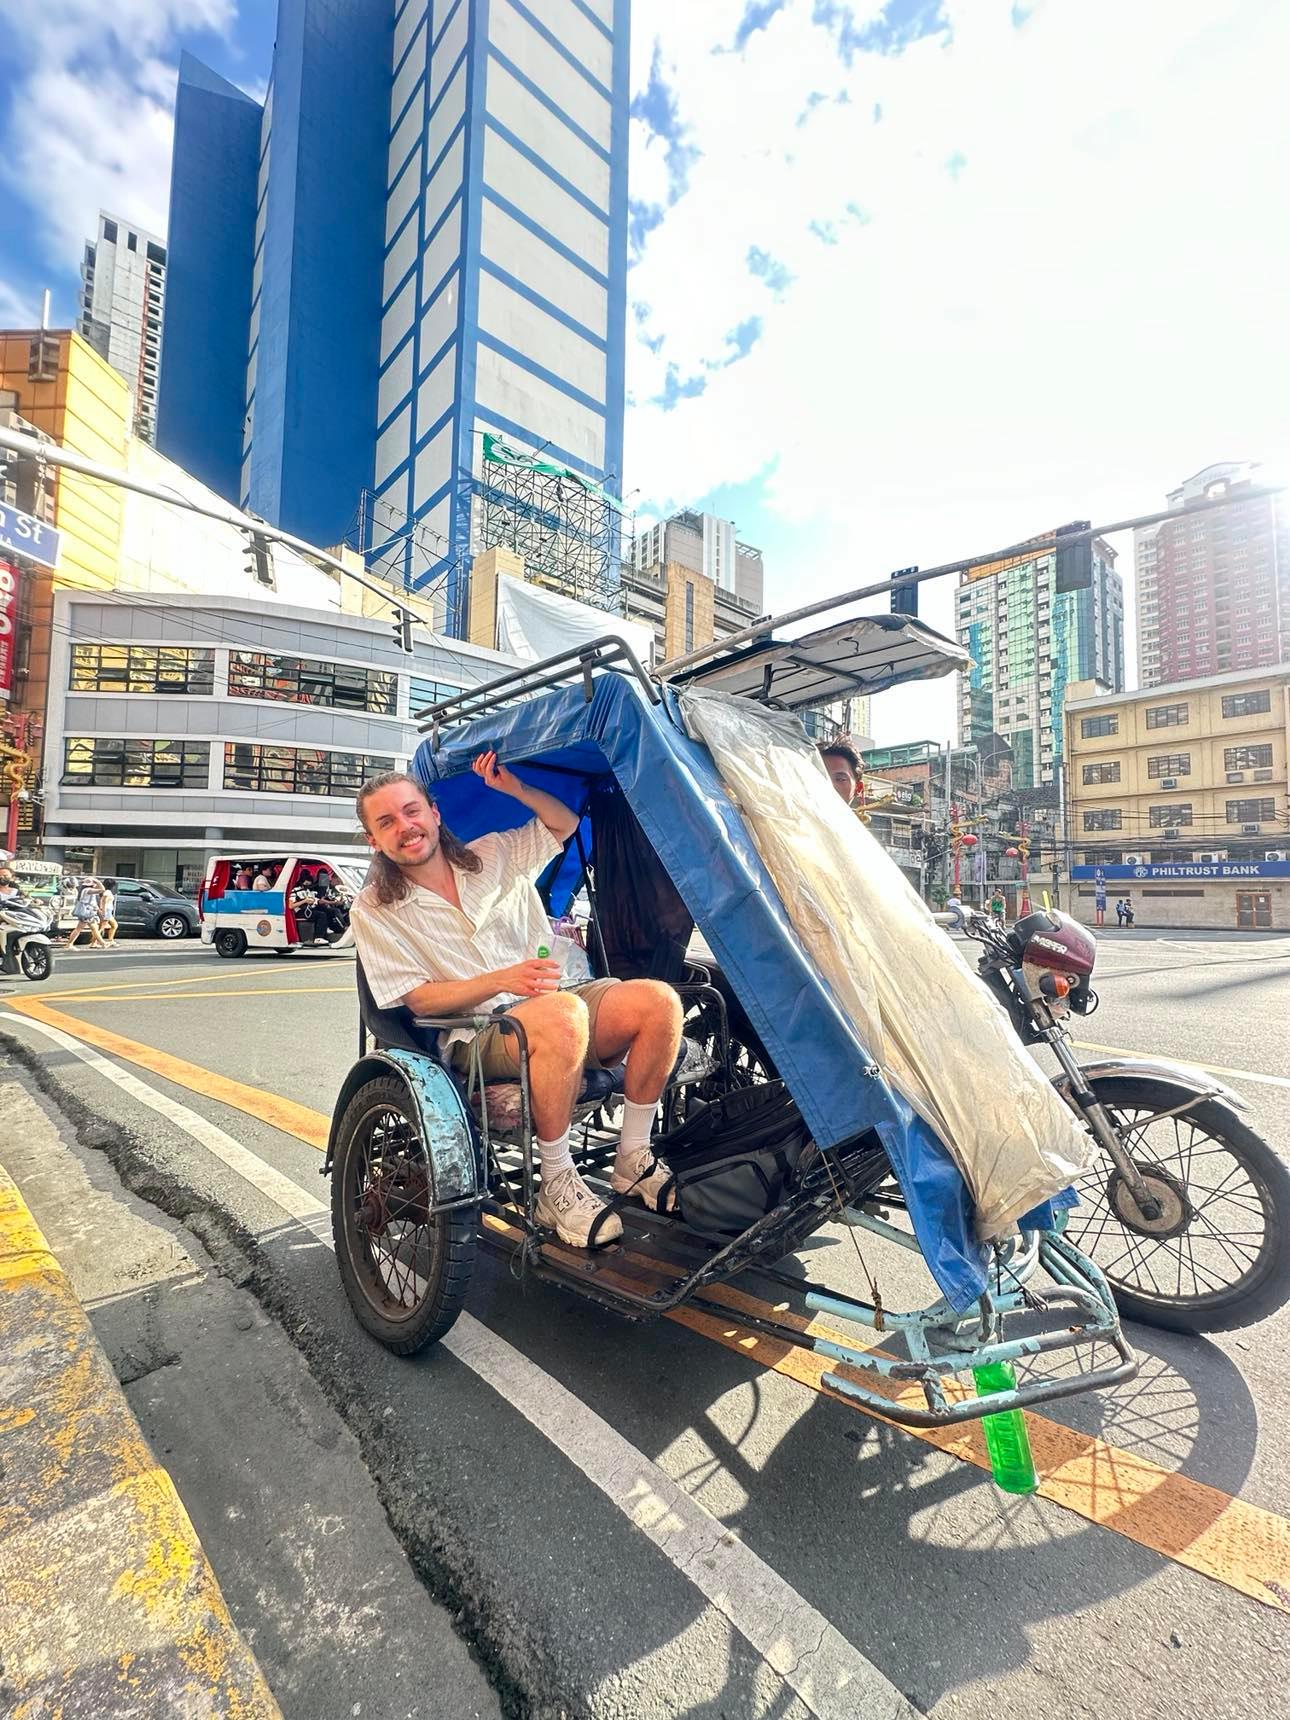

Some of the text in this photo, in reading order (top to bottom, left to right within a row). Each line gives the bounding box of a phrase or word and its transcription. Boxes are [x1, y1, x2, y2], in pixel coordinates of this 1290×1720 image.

[14, 515, 42, 544] St
[1152, 865, 1260, 876] PHILTRUST BANK
